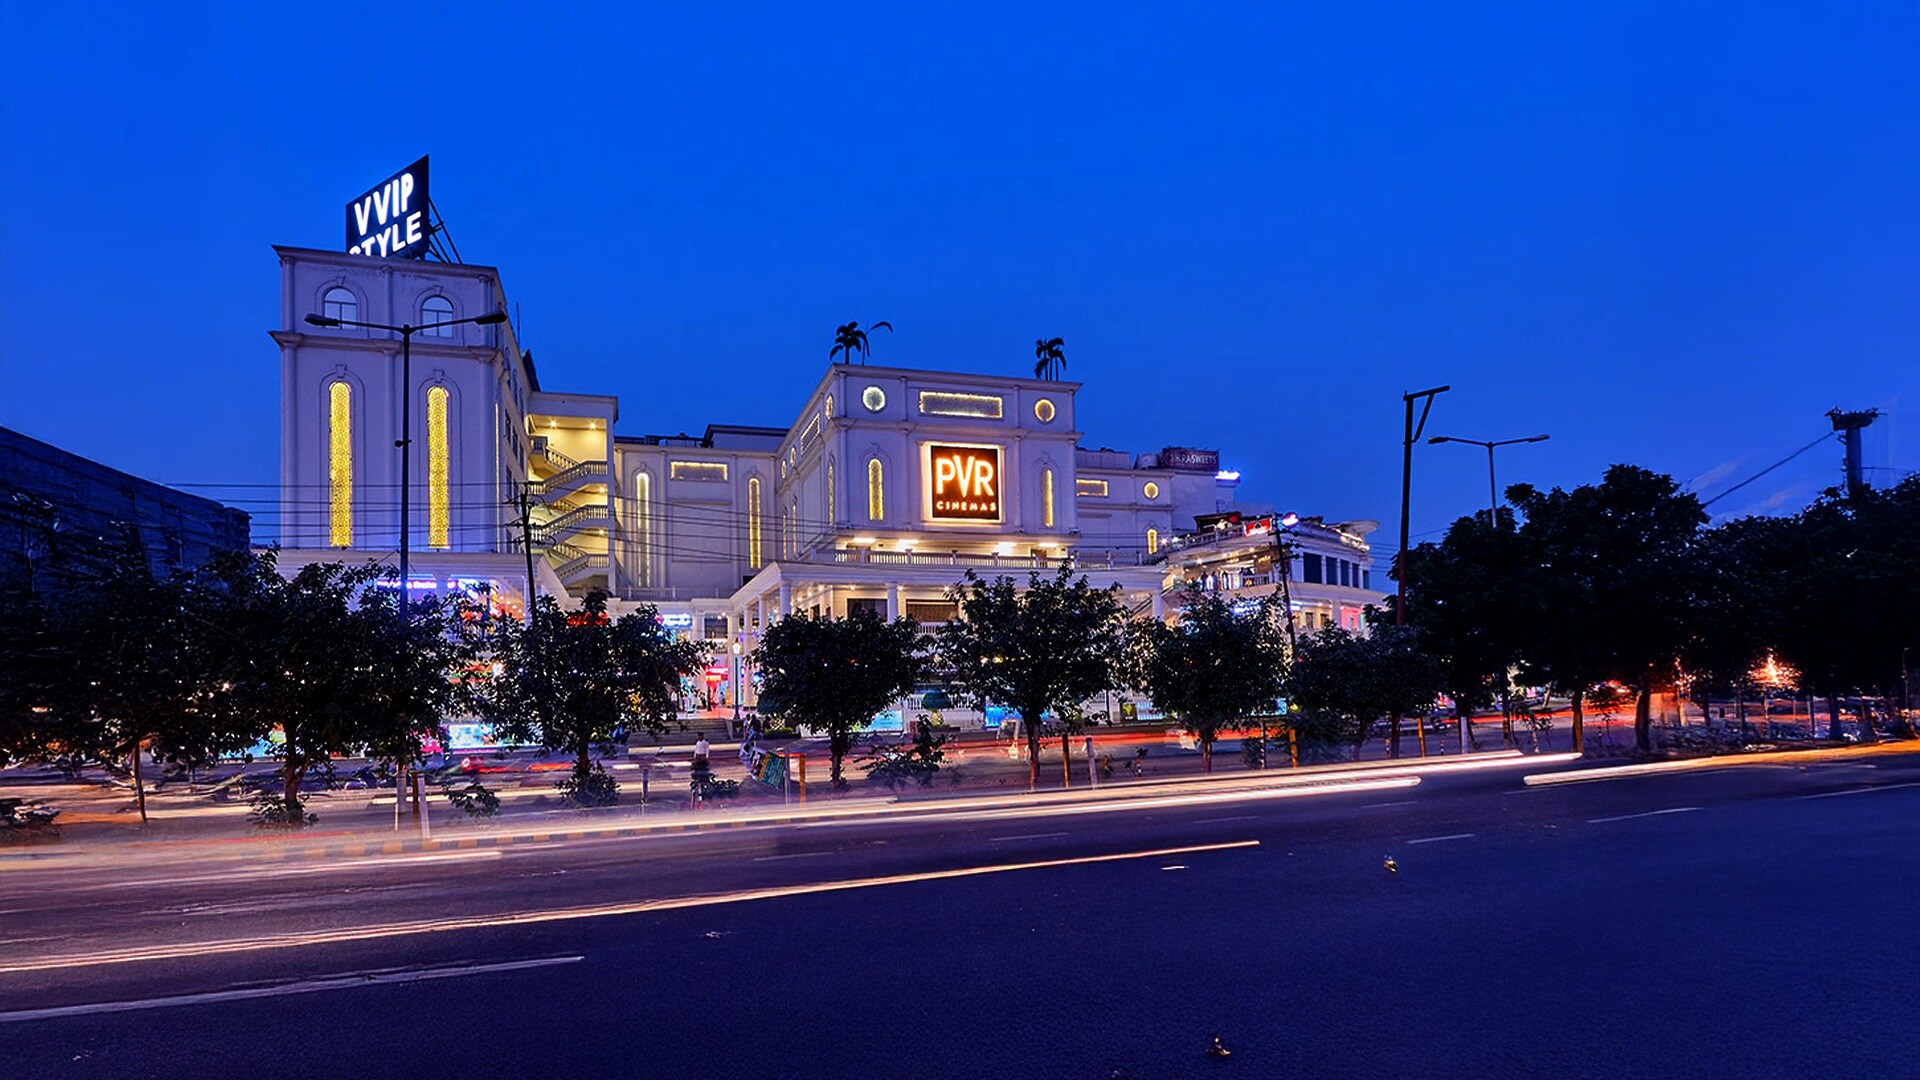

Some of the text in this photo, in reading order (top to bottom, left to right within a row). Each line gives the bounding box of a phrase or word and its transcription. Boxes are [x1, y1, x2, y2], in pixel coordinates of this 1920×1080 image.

[354, 172, 414, 236] VVIP
[935, 455, 994, 498] PVR
[936, 500, 996, 511] CINEMAS
